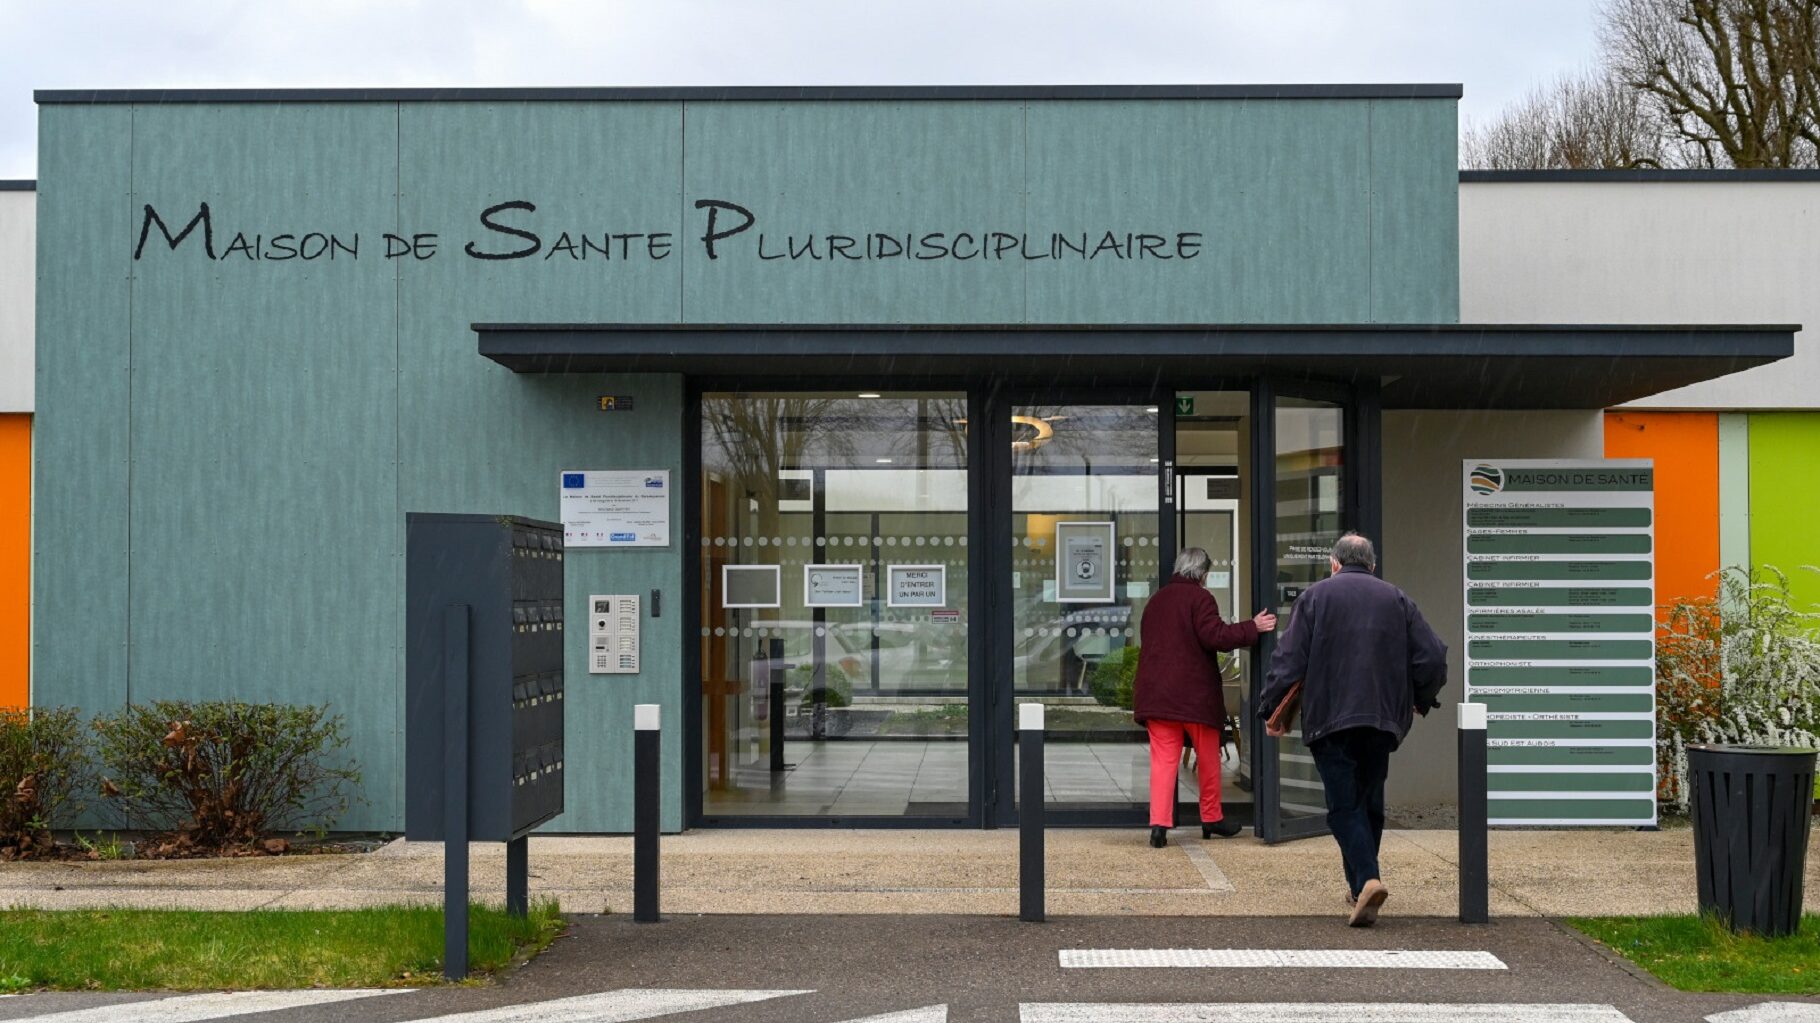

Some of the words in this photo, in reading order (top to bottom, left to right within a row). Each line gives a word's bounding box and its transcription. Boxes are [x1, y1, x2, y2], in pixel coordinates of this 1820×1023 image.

[382, 232, 438, 260] DE
[1508, 474, 1569, 485] MAISON
[1573, 474, 1594, 485] DE
[1597, 471, 1649, 485] SANTÉ
